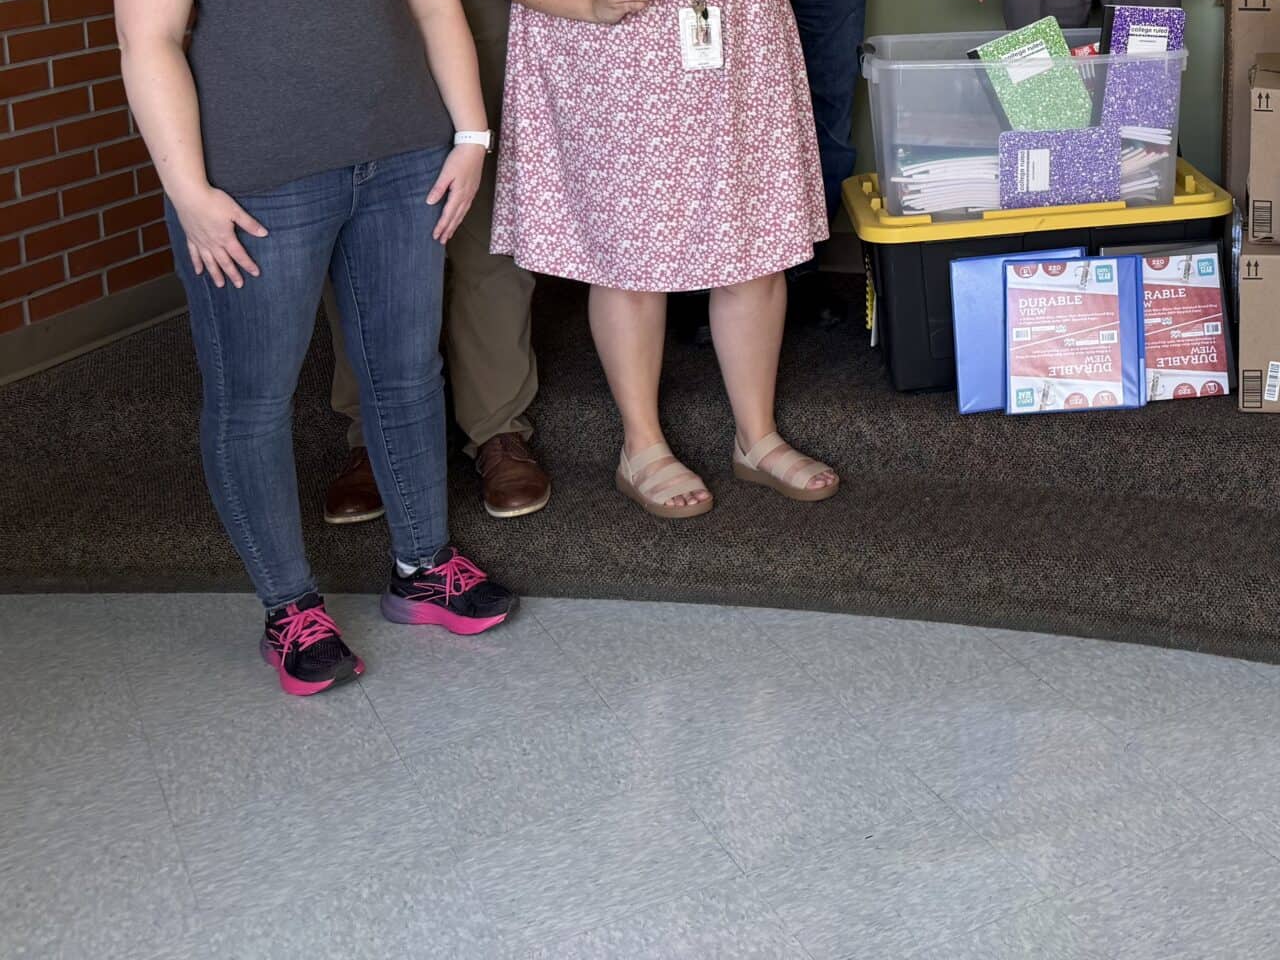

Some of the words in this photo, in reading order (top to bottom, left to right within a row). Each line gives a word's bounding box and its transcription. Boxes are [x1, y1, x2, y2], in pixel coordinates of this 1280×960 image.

[1131, 26, 1152, 35] college
[1007, 48, 1027, 60] college
[1027, 40, 1043, 51] ruled
[1144, 287, 1186, 300] RABLE
[1018, 295, 1083, 308] DURABLE
[1019, 307, 1047, 316] VIEW
[1190, 346, 1217, 355] VIEW
[1084, 354, 1112, 363] VIEW
[1156, 353, 1218, 367] DURABLE
[1048, 363, 1112, 377] DURABLE
